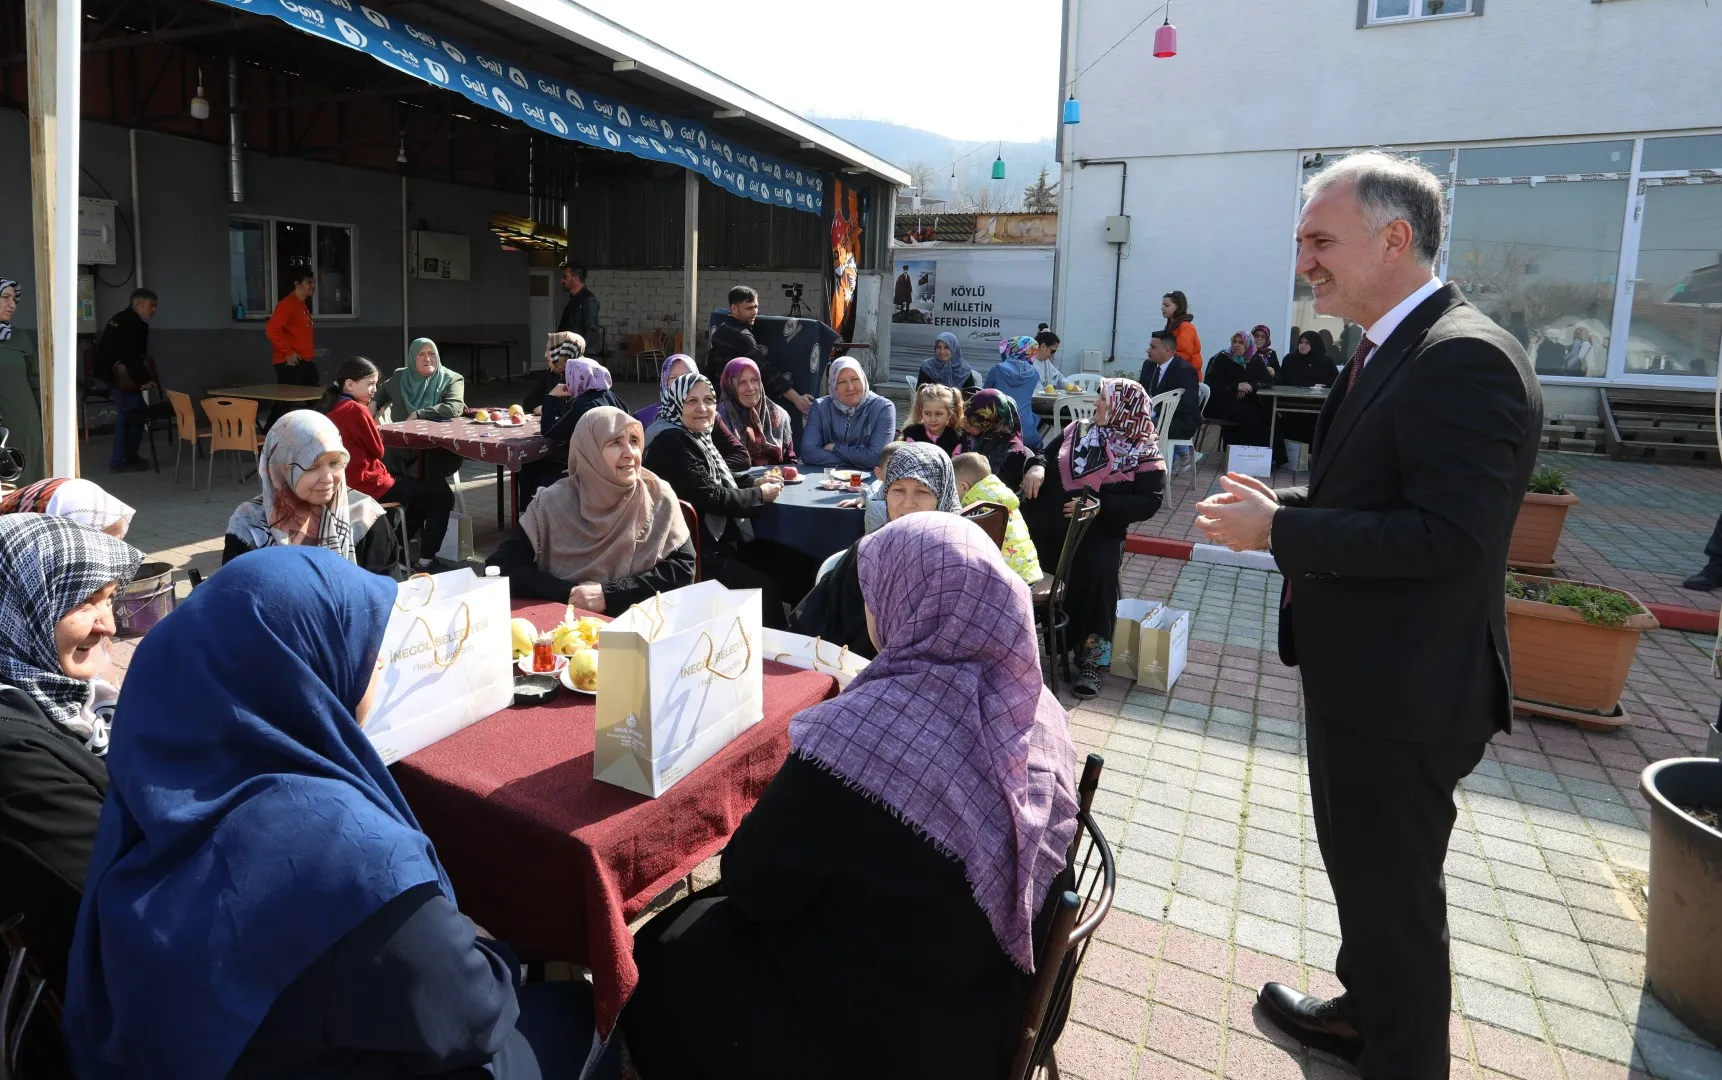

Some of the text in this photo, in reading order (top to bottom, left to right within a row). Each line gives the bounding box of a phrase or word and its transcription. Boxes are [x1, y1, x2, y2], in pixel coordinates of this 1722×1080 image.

[460, 74, 488, 97] Golf
[522, 102, 545, 122] Golf
[576, 122, 599, 138] Golf
[476, 55, 503, 76] Golf
[537, 79, 561, 99] Golf
[593, 99, 613, 117] Golf
[680, 127, 695, 141] Golf
[951, 285, 985, 297] KÖYLÜ
[943, 300, 992, 312] MİLLETİN
[934, 316, 1000, 329] EFENDİSİDİR
[389, 640, 433, 664] İNEGÖL
